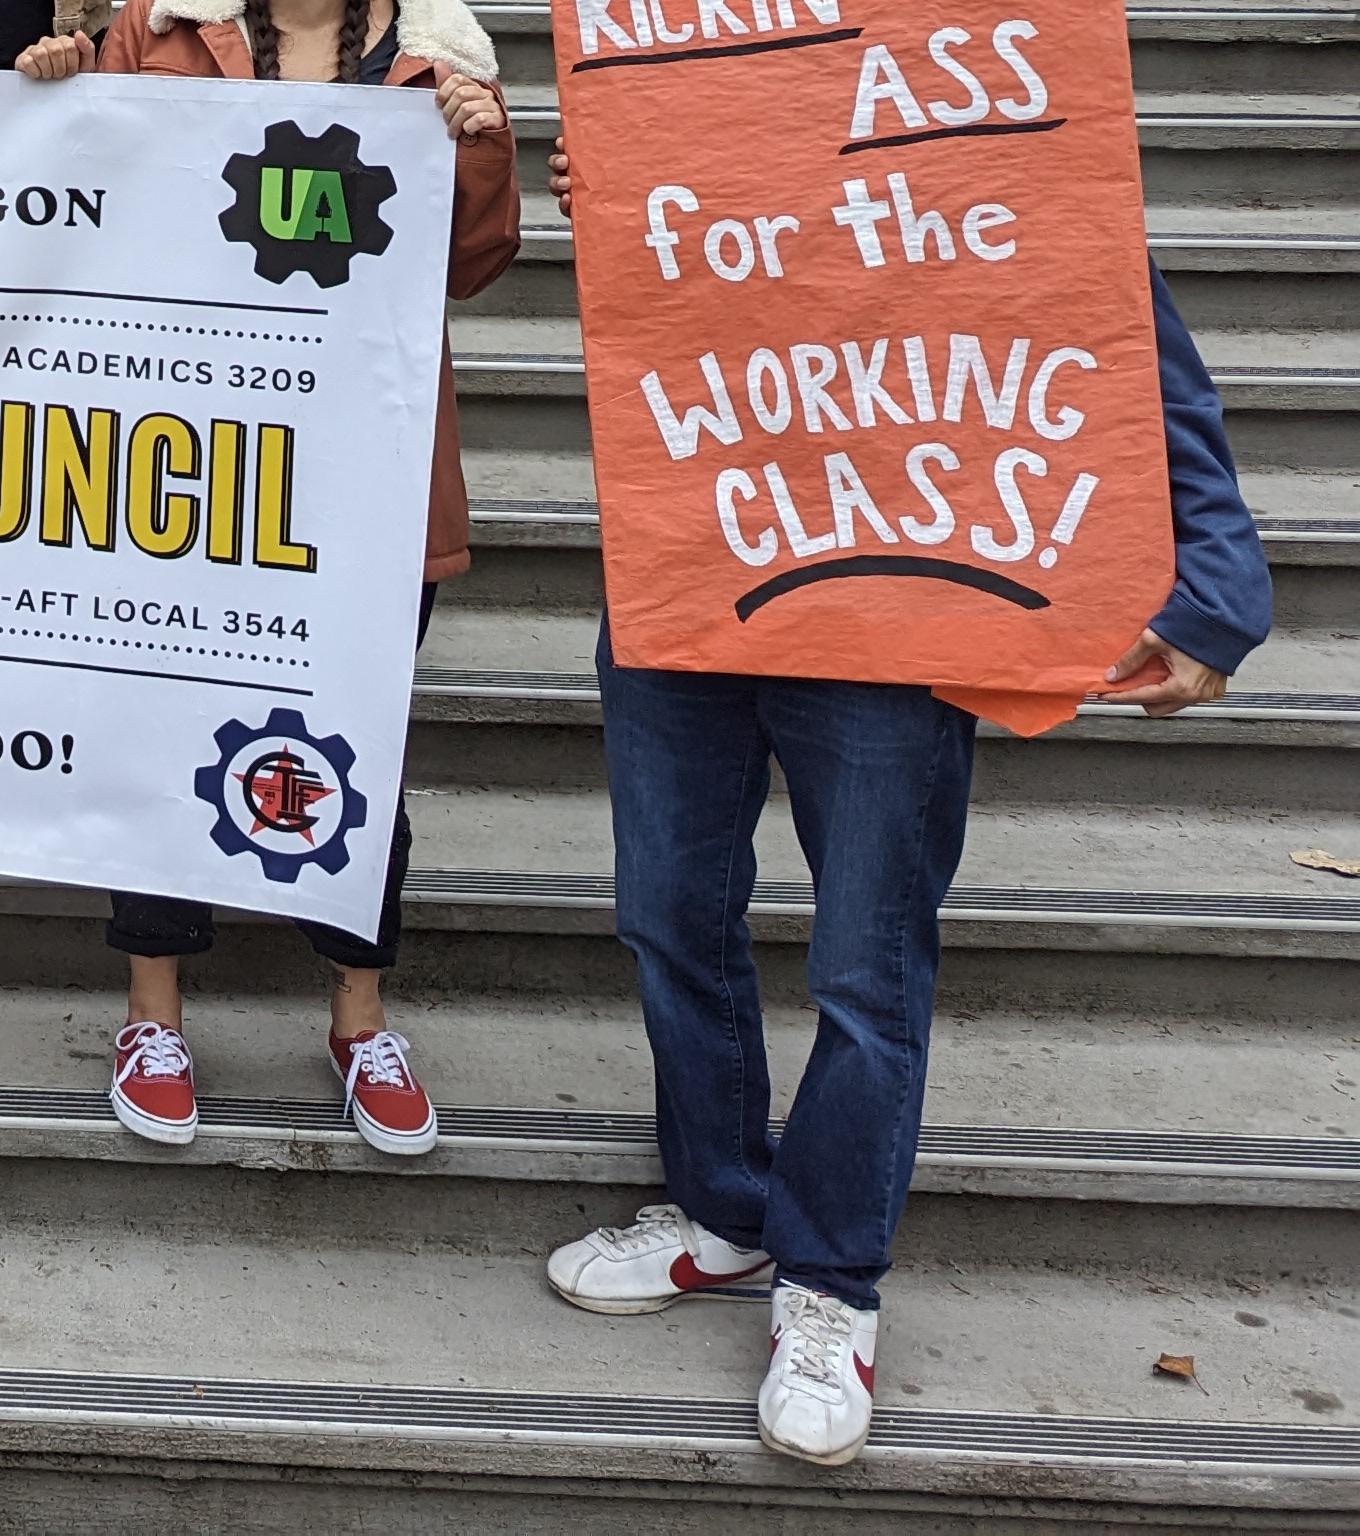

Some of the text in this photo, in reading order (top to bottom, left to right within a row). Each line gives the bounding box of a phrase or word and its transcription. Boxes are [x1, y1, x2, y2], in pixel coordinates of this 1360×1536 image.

[849, 20, 1048, 138] ASS
[259, 167, 354, 244] UA
[644, 172, 1017, 280] for the
[2, 346, 215, 387] ACADEMICS
[228, 363, 318, 395] 3209
[640, 334, 1097, 460] WORKING
[716, 443, 1100, 569] CLASS!
[94, 595, 210, 632] LOCAL
[223, 609, 311, 643] 3544
